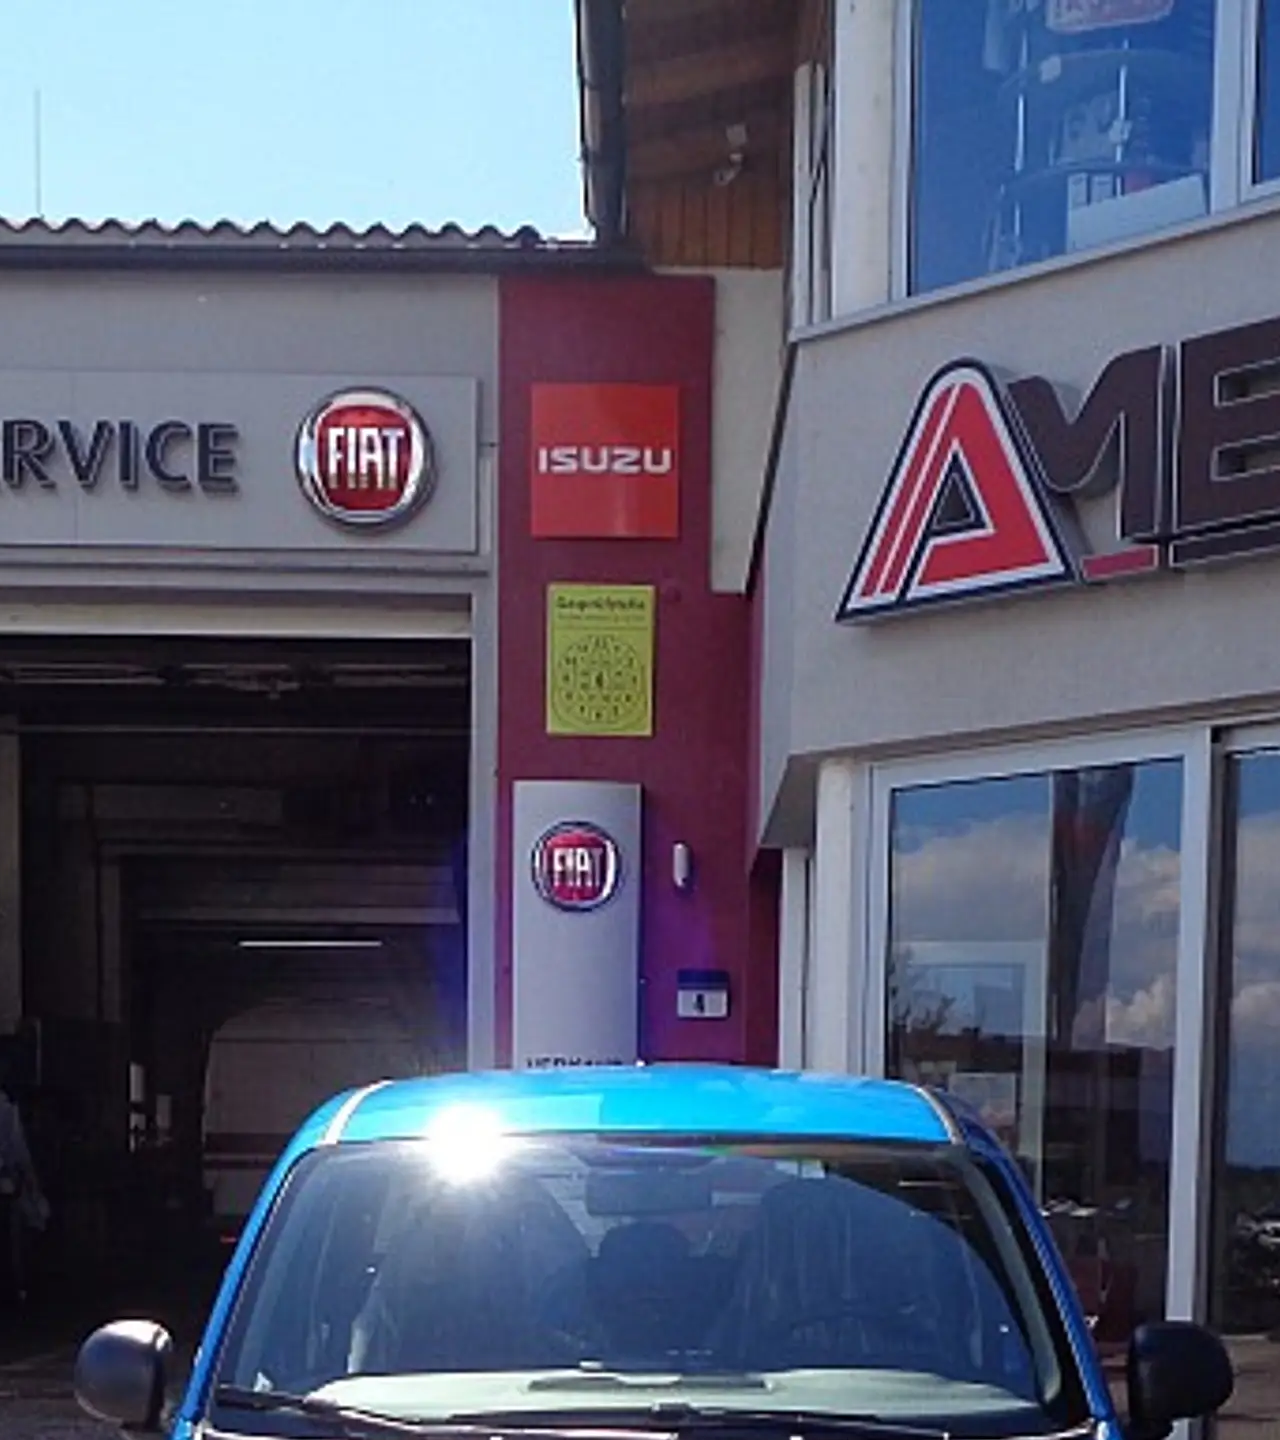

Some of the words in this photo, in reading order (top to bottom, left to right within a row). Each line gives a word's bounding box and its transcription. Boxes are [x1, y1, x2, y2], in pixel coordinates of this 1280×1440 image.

[327, 425, 406, 490] FIAT
[538, 446, 672, 474] ISUZU
[553, 847, 603, 888] FIAT
